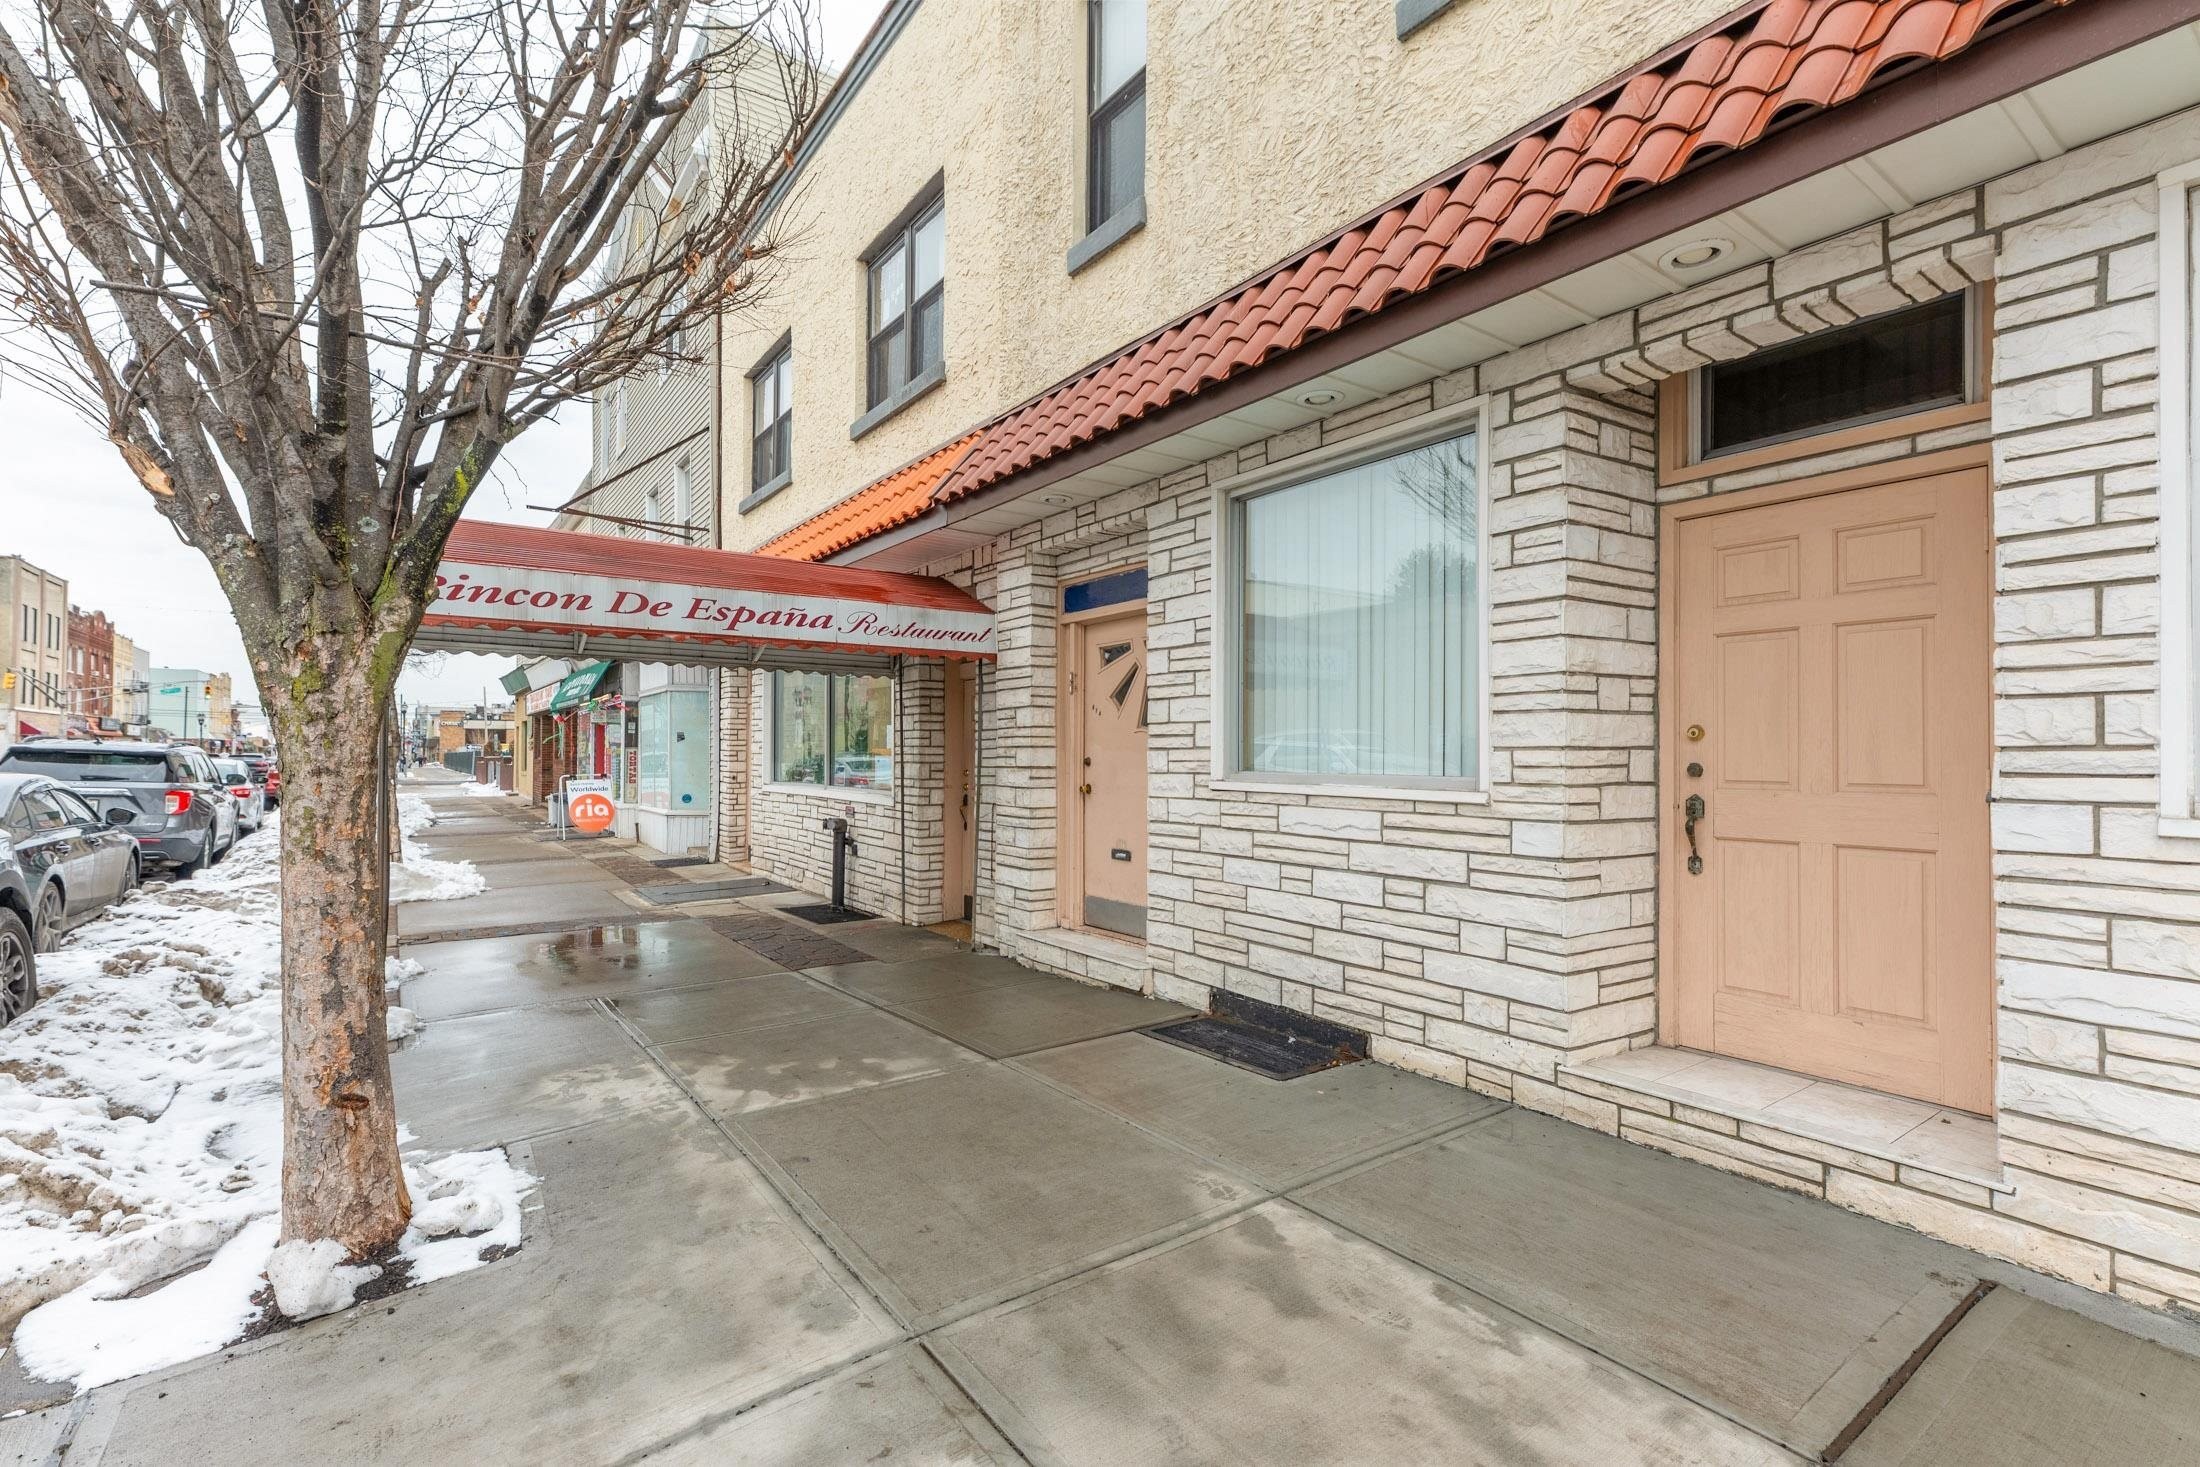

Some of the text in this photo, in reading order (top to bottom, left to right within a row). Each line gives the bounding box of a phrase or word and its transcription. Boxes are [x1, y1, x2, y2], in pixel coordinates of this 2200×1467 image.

[605, 590, 673, 618] De
[682, 597, 833, 632] España
[836, 610, 992, 644] Restaurant
[570, 785, 609, 793] Worldwide
[575, 798, 609, 817] ria
